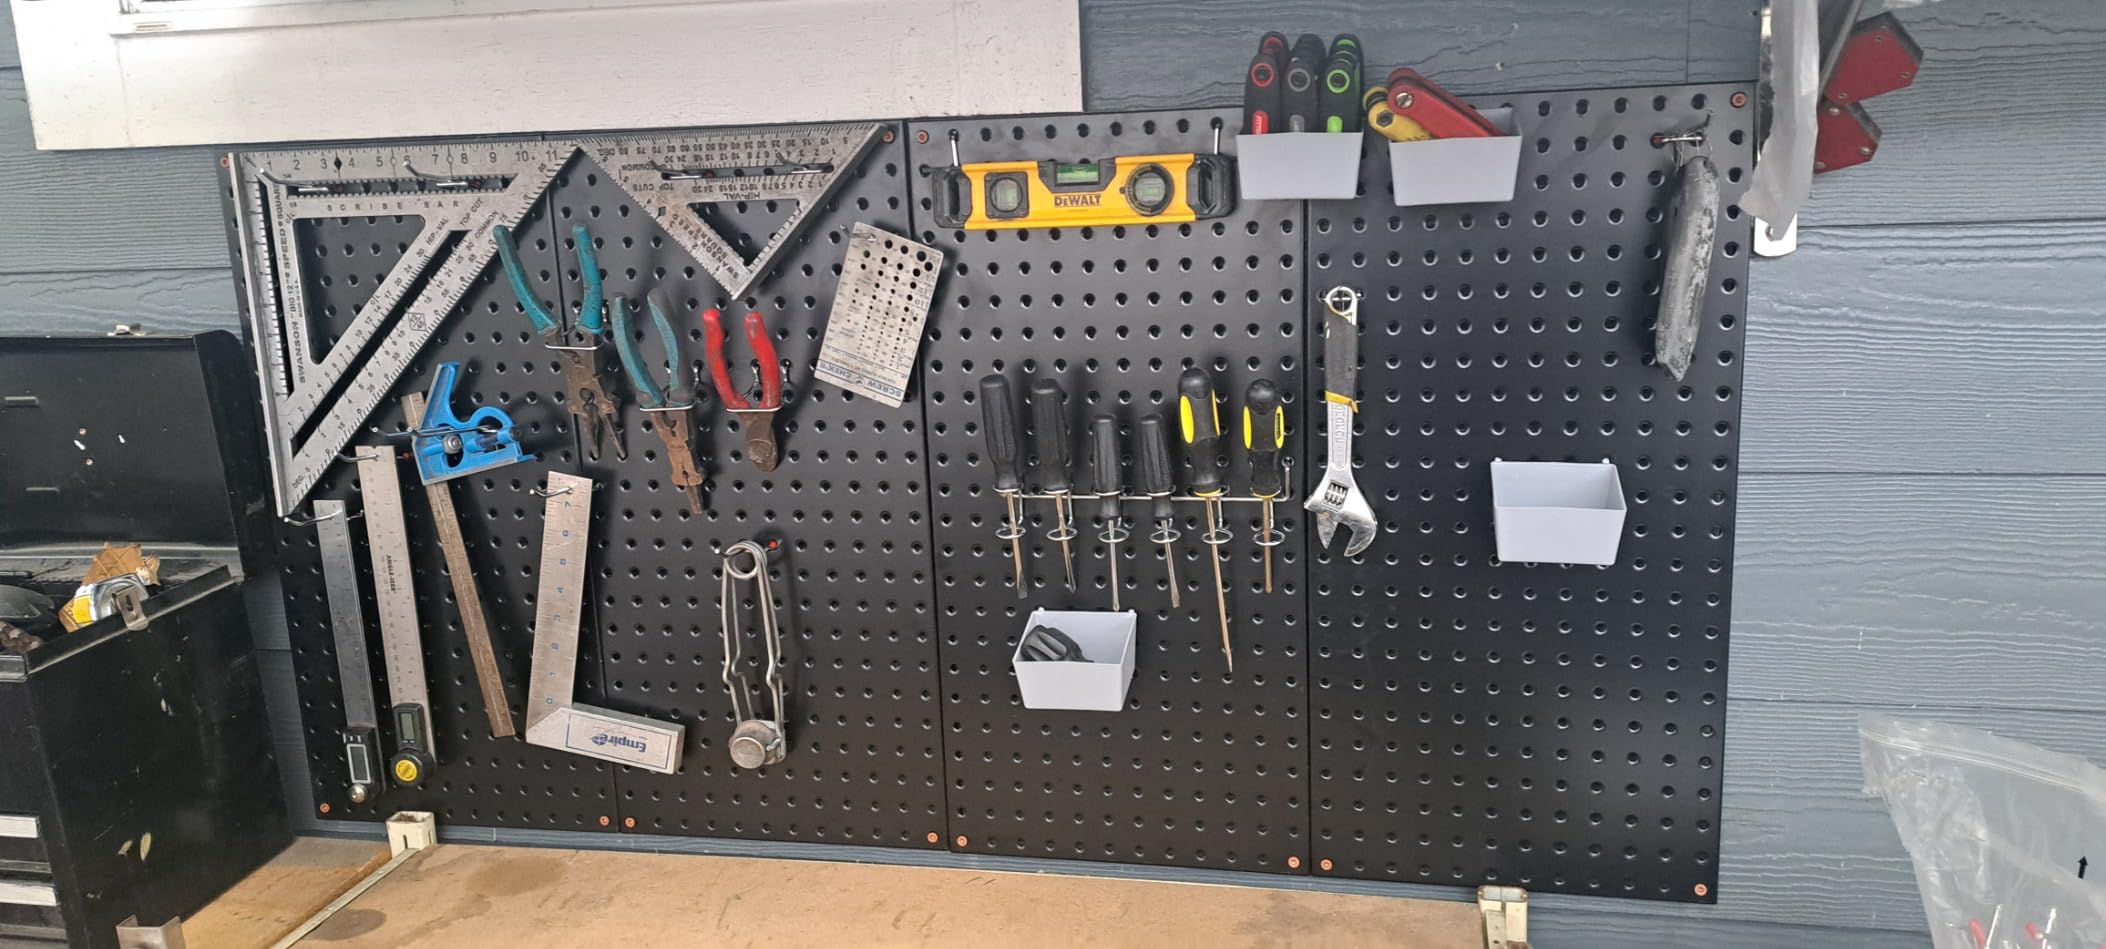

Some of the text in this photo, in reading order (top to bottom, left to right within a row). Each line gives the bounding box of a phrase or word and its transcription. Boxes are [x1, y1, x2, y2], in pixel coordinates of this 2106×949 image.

[267, 160, 273, 171] 1
[293, 159, 301, 171] 2
[320, 158, 328, 169] 3
[348, 157, 356, 168] 4
[376, 156, 384, 167] 5
[432, 154, 439, 165] 7
[461, 153, 469, 164] 8
[489, 152, 497, 163] 9
[515, 151, 529, 162] 10
[546, 150, 557, 161] 11
[723, 192, 760, 200] HIP-VAL
[1054, 193, 1101, 207] DEWALT
[459, 198, 484, 227] TOP CUT
[474, 209, 499, 239] COMMON
[292, 321, 305, 384] SWANSON
[867, 380, 902, 397] SCREW
[591, 733, 647, 753] Empire
